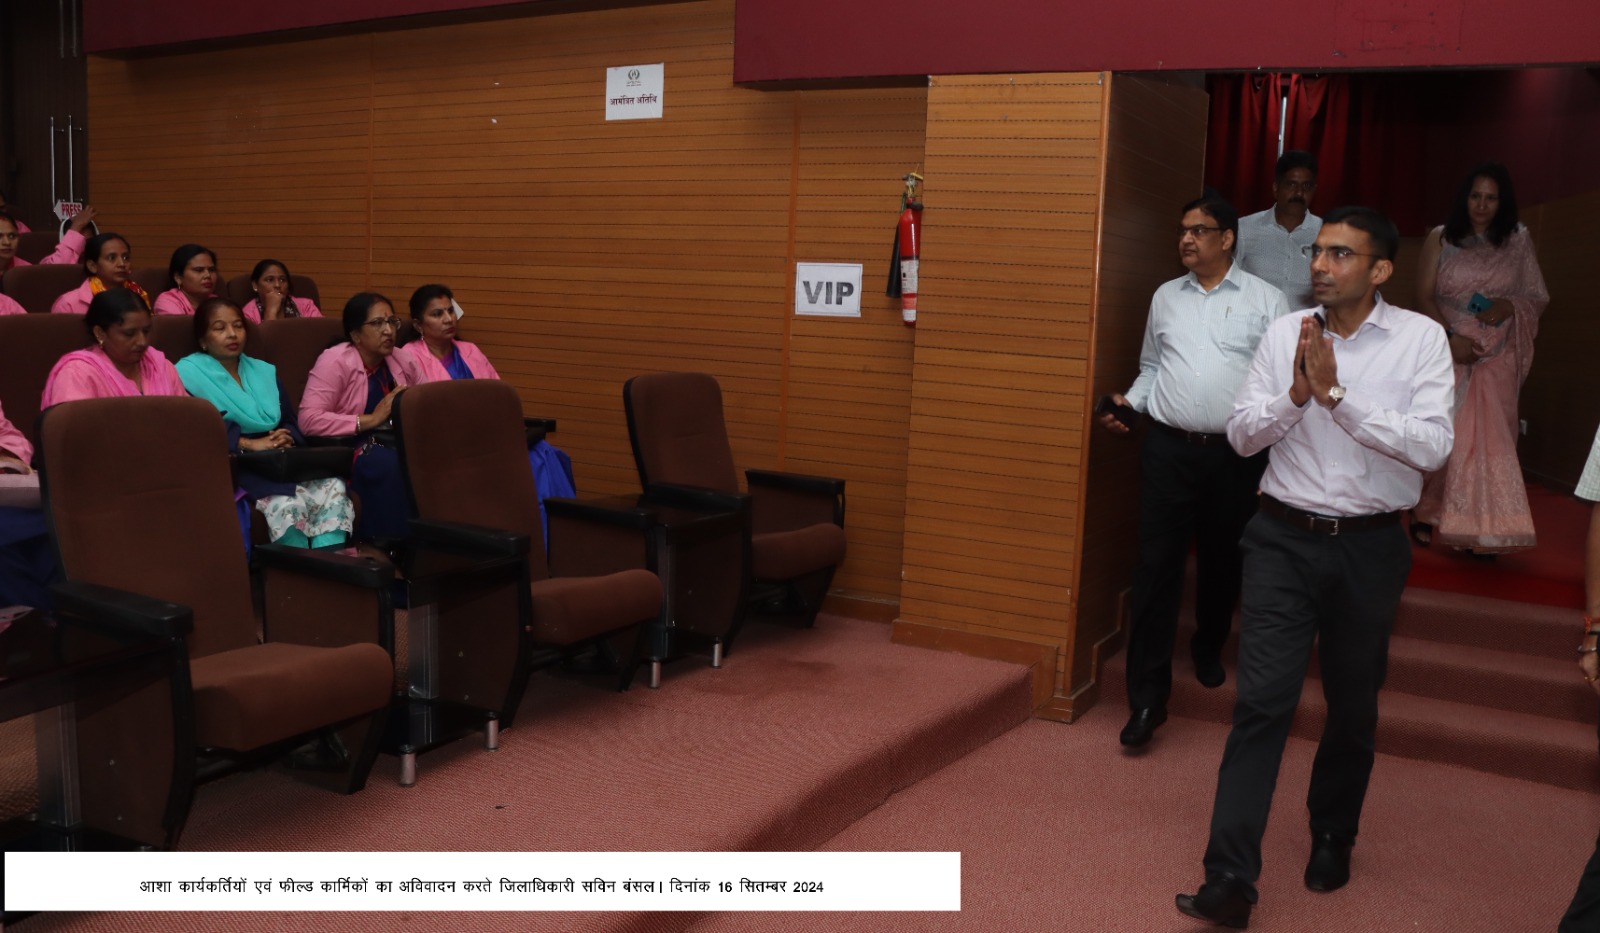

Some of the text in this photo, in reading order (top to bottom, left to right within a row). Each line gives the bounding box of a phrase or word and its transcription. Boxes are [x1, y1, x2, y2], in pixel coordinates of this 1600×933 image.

[637, 93, 657, 104] अतिथि
[61, 203, 81, 217] PRESS
[802, 280, 854, 305] VIP
